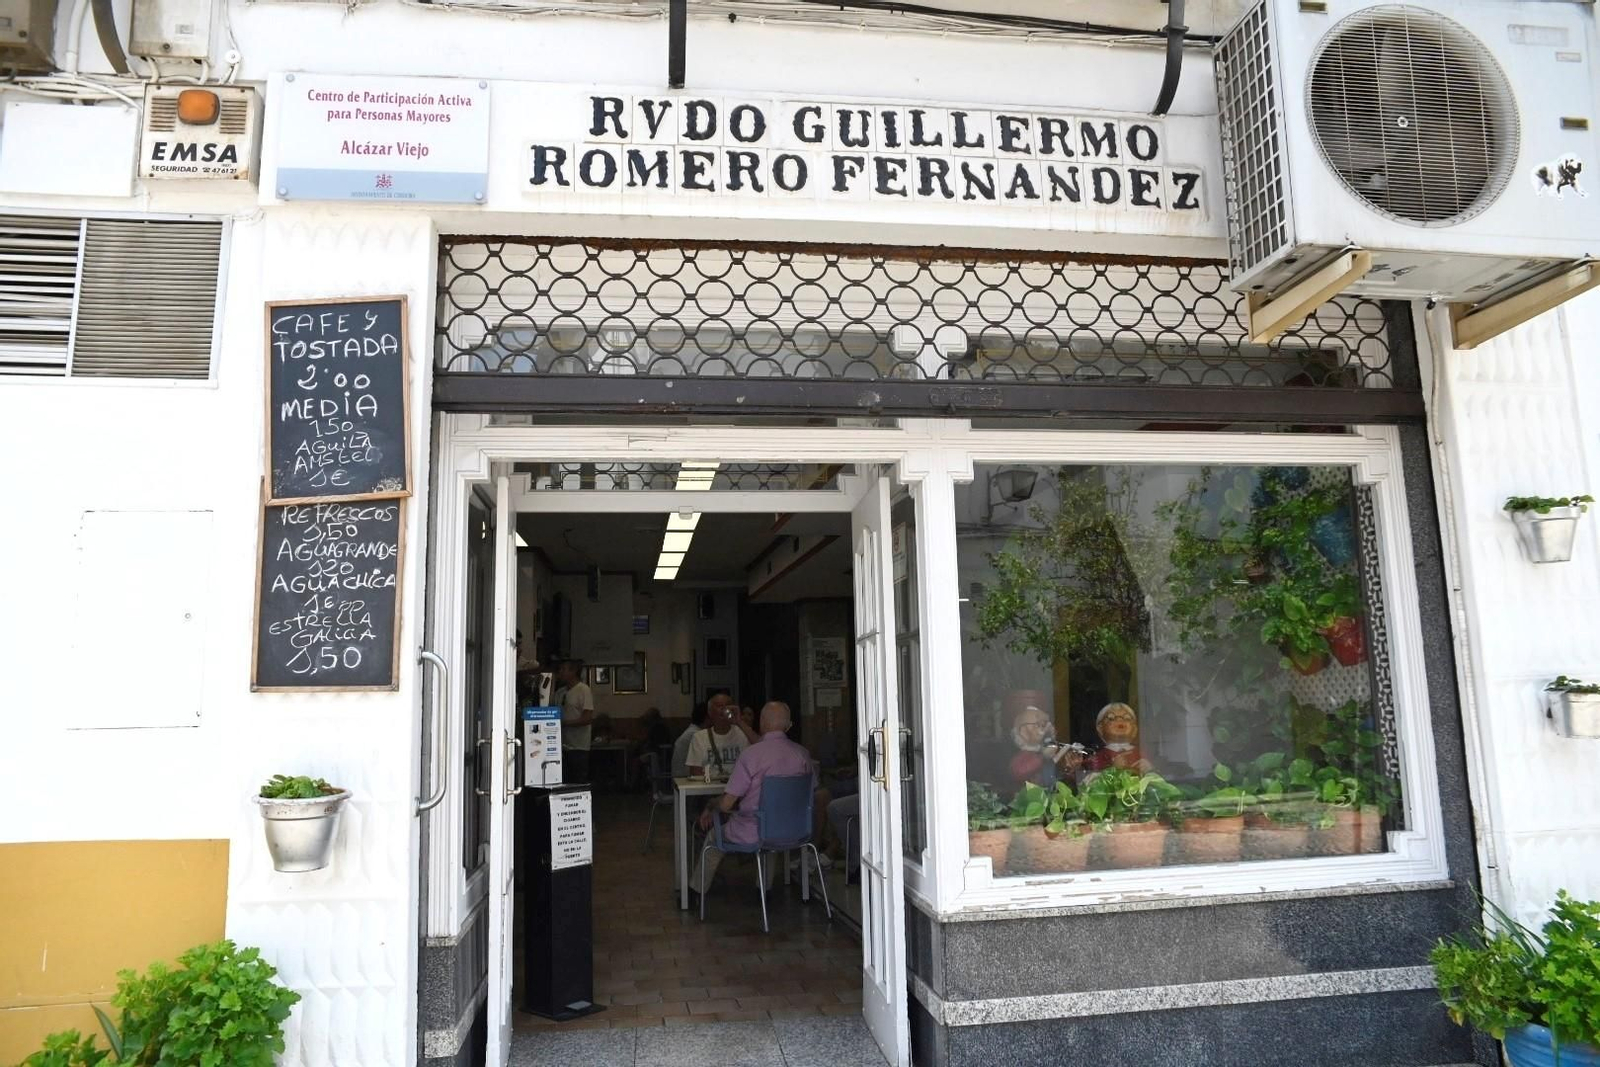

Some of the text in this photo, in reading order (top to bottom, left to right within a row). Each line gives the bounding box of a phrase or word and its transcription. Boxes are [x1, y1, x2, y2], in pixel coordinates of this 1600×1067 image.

[307, 89, 472, 107] Centro de Participación Activa
[327, 108, 451, 125] para Personas Mayores
[588, 96, 1160, 161] RVDO GUILLERMO
[151, 141, 238, 163] EMSA
[340, 140, 430, 159] Alcázar Viejo
[151, 165, 198, 173] SEGURIDAD
[530, 144, 1201, 210] ROMERO FERNANDEZ
[273, 333, 398, 363] TOSTADA
[281, 503, 398, 526] REFRESCOS
